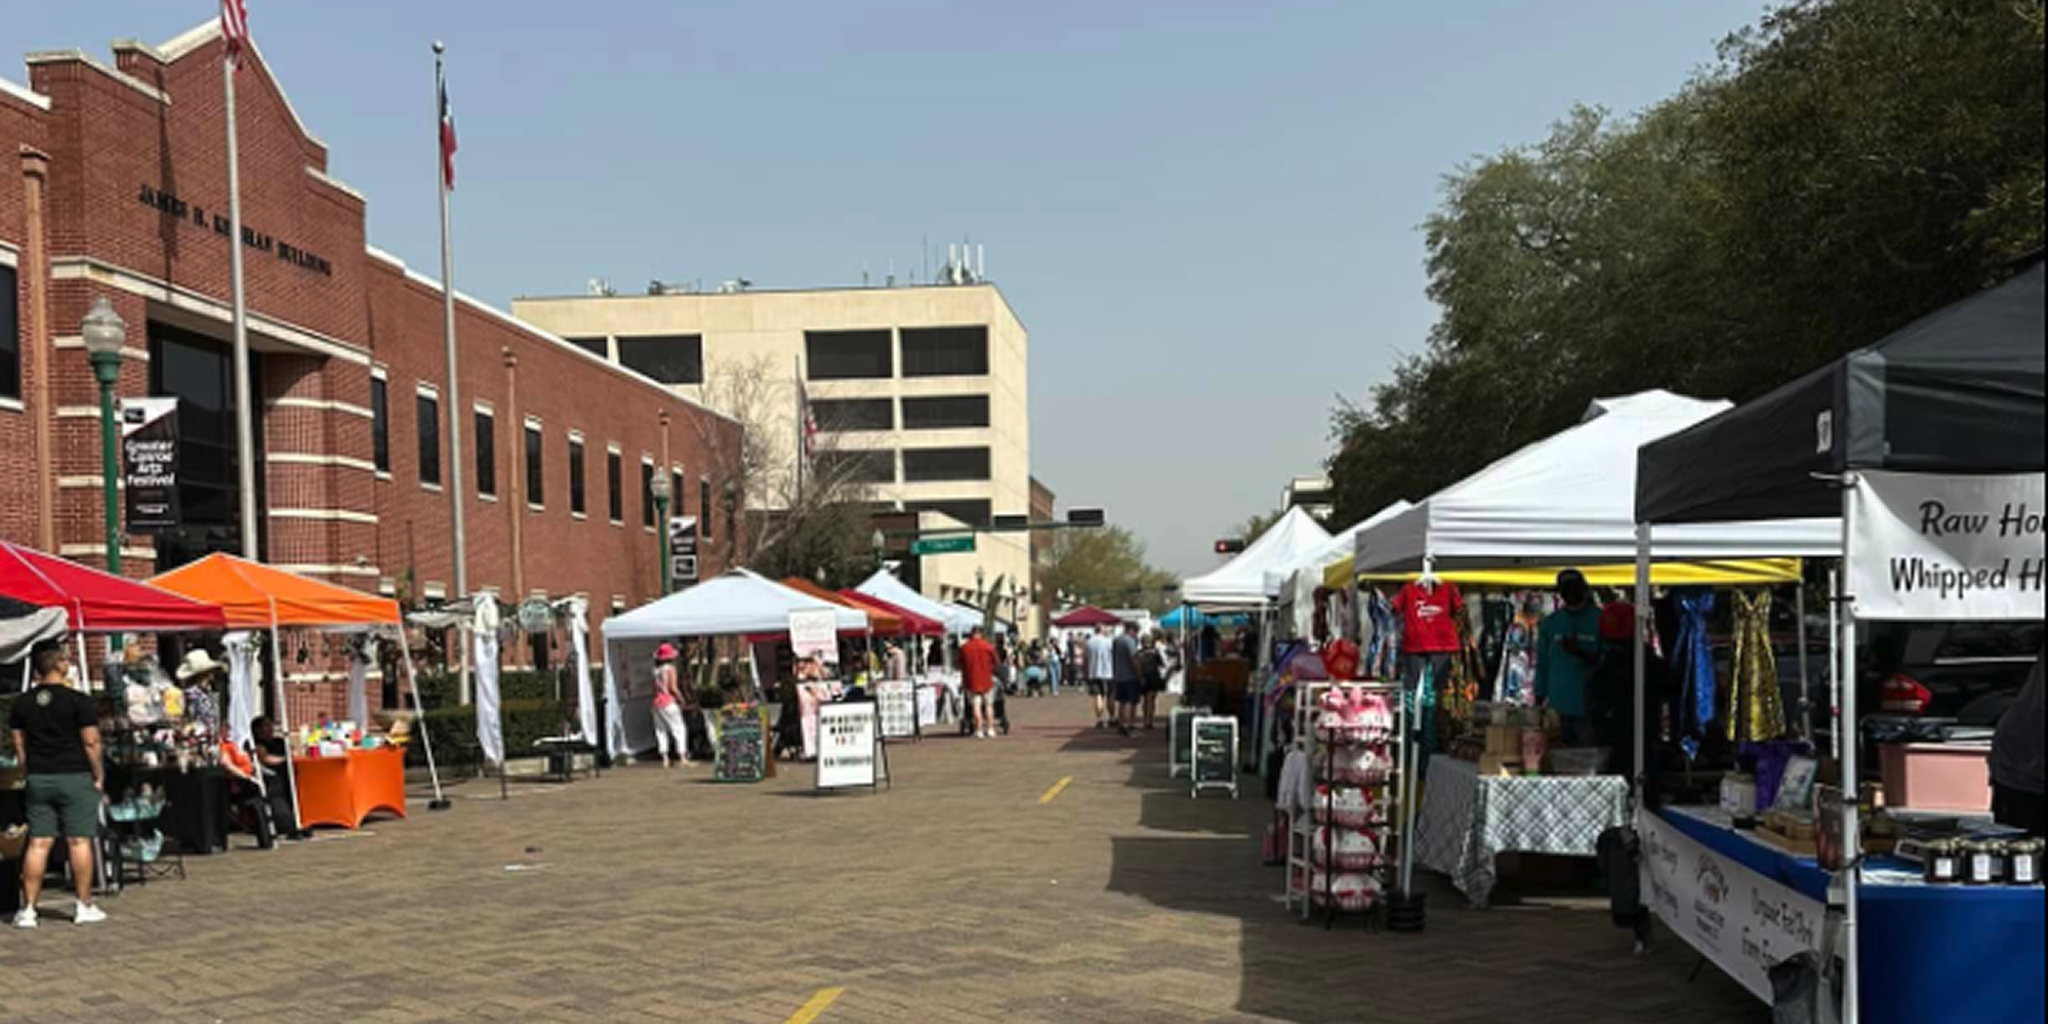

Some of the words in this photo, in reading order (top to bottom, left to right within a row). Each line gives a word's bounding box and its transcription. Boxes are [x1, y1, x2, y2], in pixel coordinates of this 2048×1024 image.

[139, 184, 187, 219] JAMES
[277, 241, 332, 277] BUILDING
[125, 439, 174, 452] Greater
[128, 452, 174, 463] Conroe
[136, 462, 163, 475] Arts
[126, 473, 175, 487] Festival
[1918, 499, 1989, 538] Raw
[1889, 556, 2010, 600] Whipped
[2018, 557, 2046, 592] H
